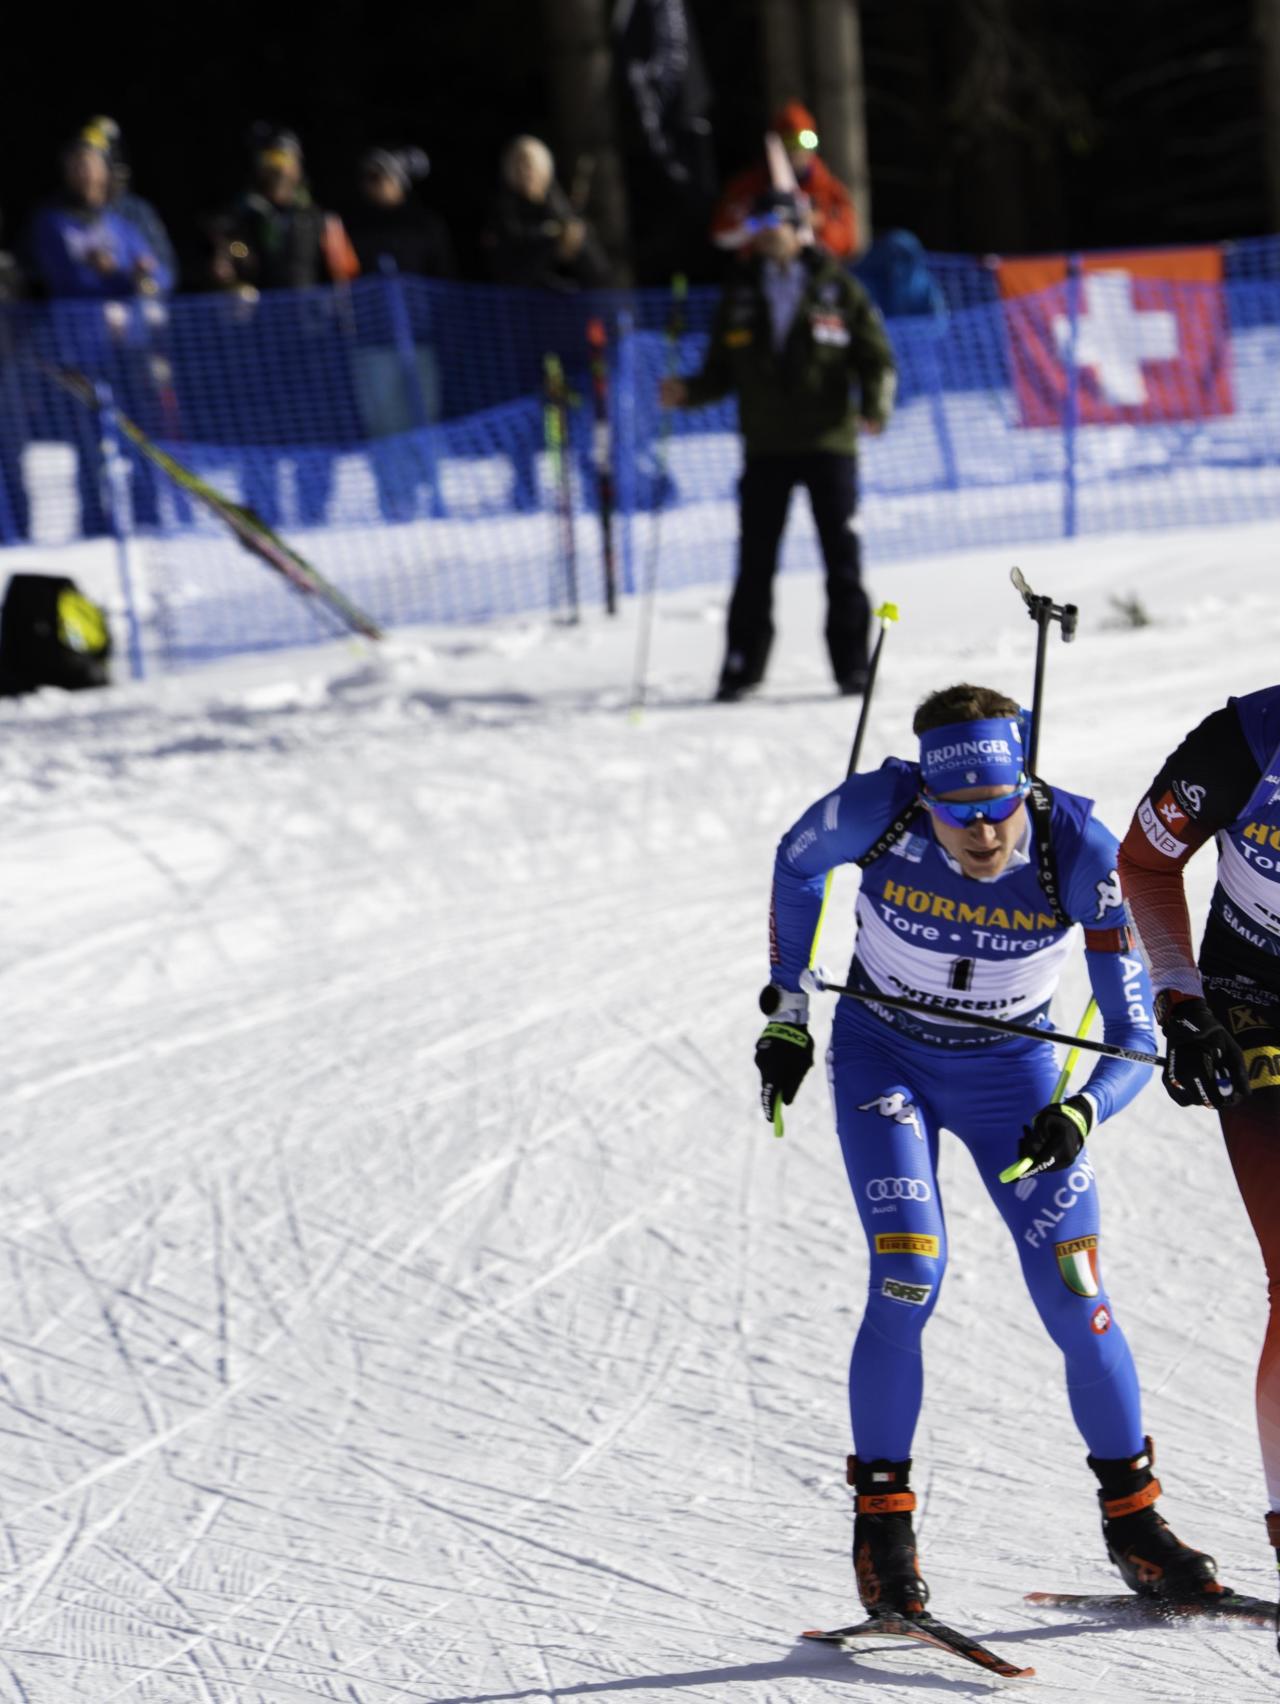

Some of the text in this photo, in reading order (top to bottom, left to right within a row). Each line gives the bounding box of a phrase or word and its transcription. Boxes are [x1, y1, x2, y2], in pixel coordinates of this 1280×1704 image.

[926, 740, 1011, 766] ERDINGER
[1141, 807, 1177, 853] DNB
[881, 904, 1054, 952] Tore Türen
[947, 957, 976, 991] 1
[872, 1204, 897, 1214] Audi
[880, 1236, 934, 1252] PIRELLI
[884, 1281, 931, 1302] FORST
